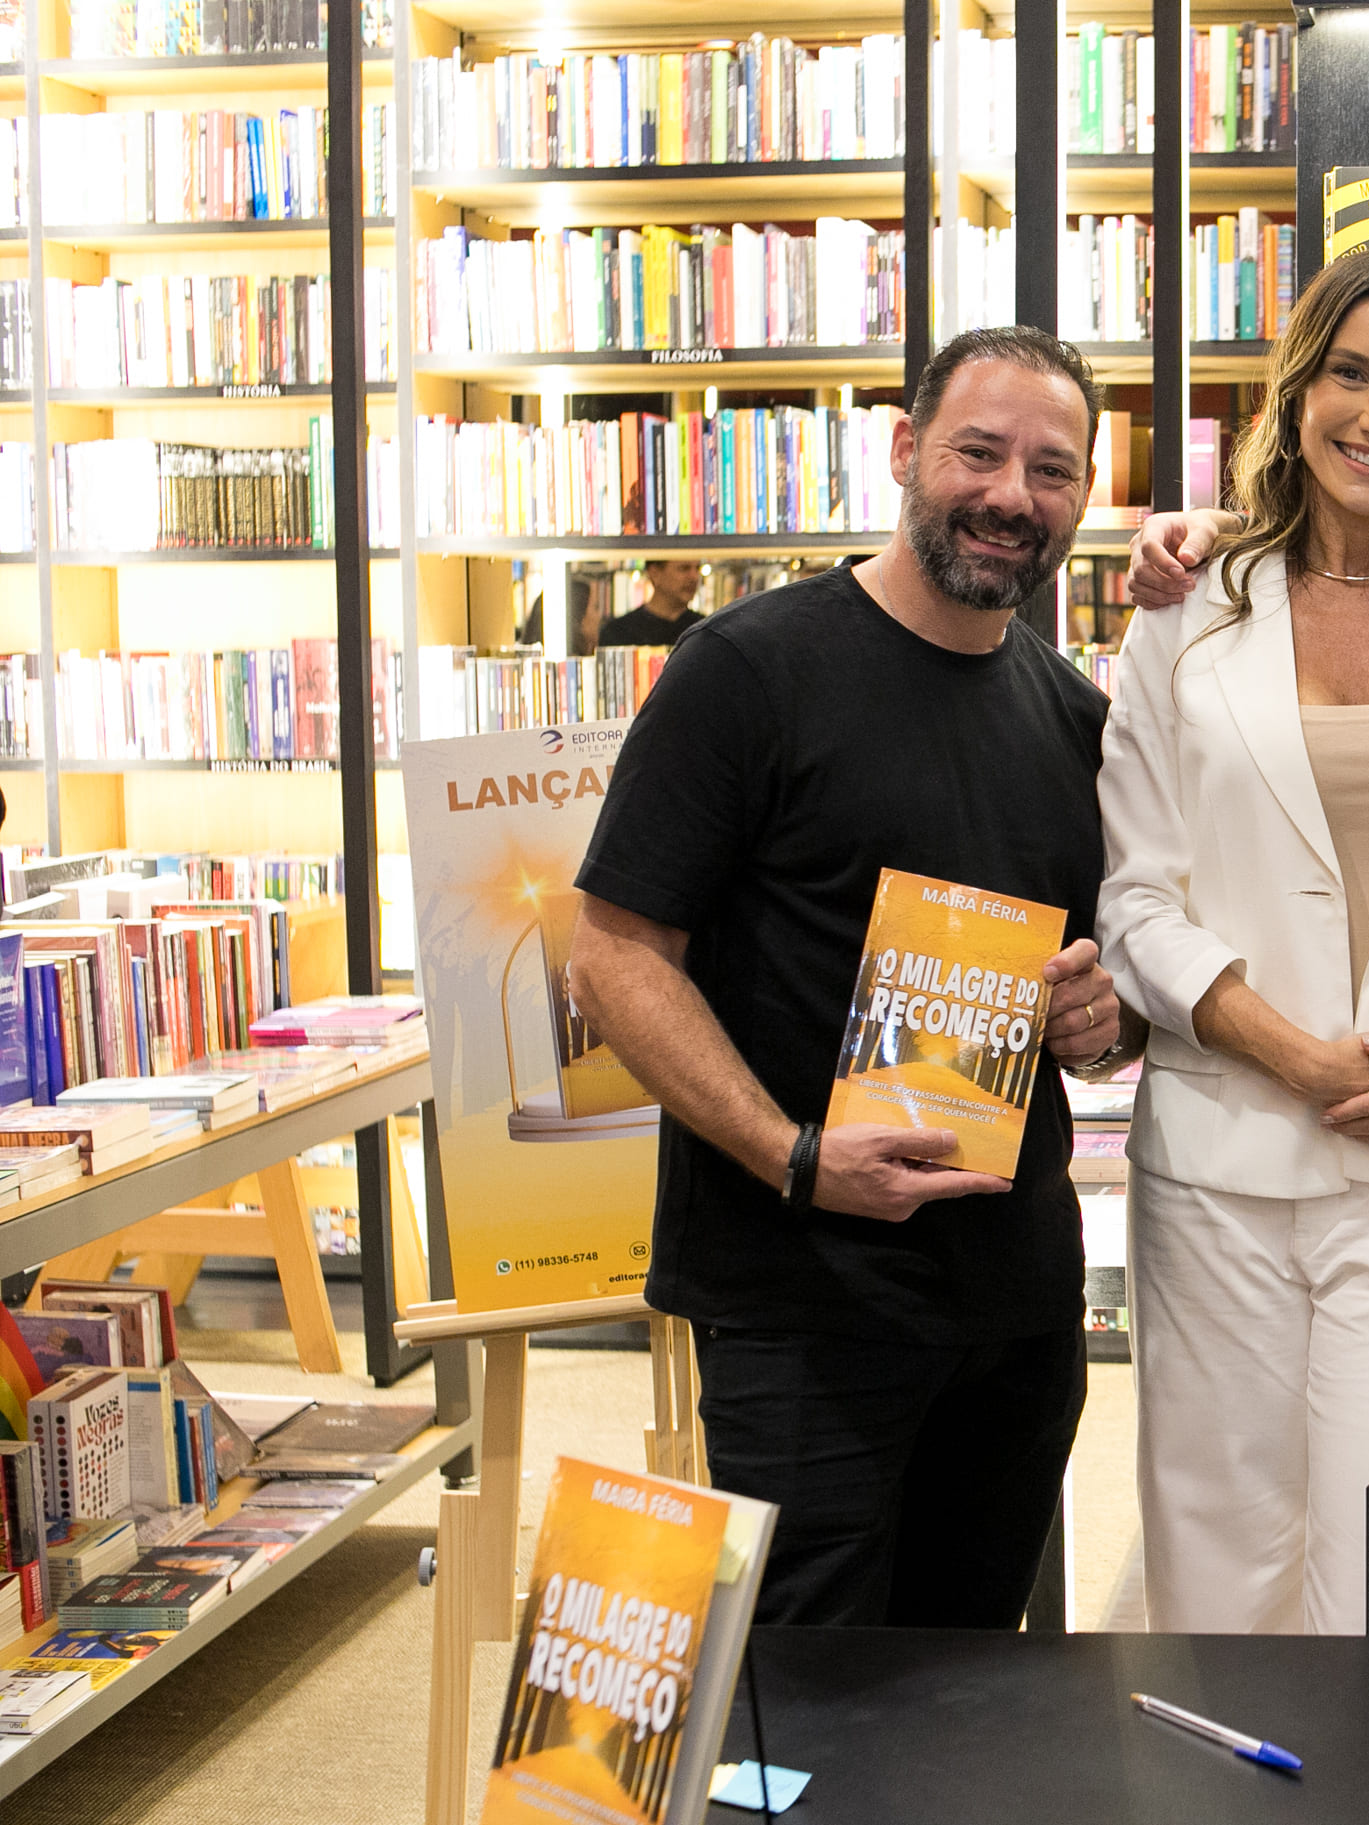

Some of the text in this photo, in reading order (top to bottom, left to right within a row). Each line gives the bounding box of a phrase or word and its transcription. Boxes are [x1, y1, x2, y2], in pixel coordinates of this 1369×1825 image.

[651, 349, 724, 364] FILOSOFIA
[572, 730, 623, 744] EDITORA
[269, 760, 289, 772] DO
[291, 760, 332, 773] BRASIL
[447, 765, 616, 812] LANÇA
[981, 900, 1028, 925] FÉRIA
[880, 948, 1039, 1009] O MILAGRE DO
[869, 986, 1031, 1059] RECOMEÇO
[515, 1251, 599, 1272] (11) 98336-5748
[76, 1408, 124, 1451] Negras
[85, 1396, 120, 1427] Vozes
[648, 1491, 694, 1527] FÉRIA
[543, 1572, 693, 1664] O MILAGRE DO
[526, 1630, 678, 1744] RECOMEÇO
